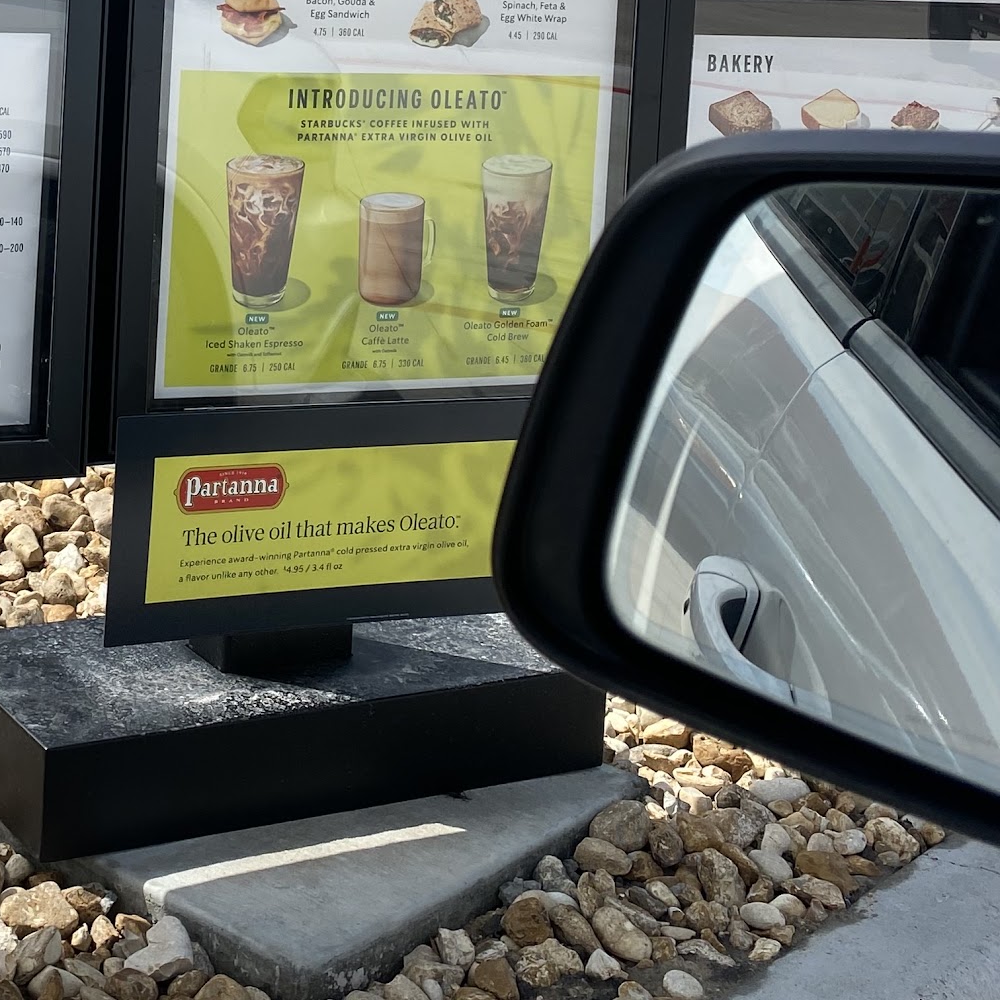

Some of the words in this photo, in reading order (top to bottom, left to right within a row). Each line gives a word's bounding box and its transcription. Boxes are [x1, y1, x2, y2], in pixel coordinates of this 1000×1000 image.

[707, 54, 774, 73] BAKERY
[288, 88, 422, 109] INTRODUCING
[369, 119, 408, 128] COFFEE
[411, 119, 457, 128] INFUSED
[460, 120, 490, 129] WITH
[361, 132, 395, 141] EXTRA
[398, 132, 436, 142] VIRGIN
[440, 133, 471, 142] OLIVE
[474, 133, 492, 142] OIL
[205, 340, 226, 349] Iced
[227, 339, 262, 349] Shaken
[263, 339, 304, 349] Espresso
[209, 364, 238, 373] GRANDE
[242, 363, 257, 373] 6.75
[268, 362, 282, 372] 250
[283, 362, 295, 371] CAL
[184, 476, 278, 507] Partanna
[182, 527, 218, 547] The
[221, 524, 265, 544] olive
[269, 521, 291, 541] oil
[296, 519, 332, 539] that
[336, 515, 395, 536] makes
